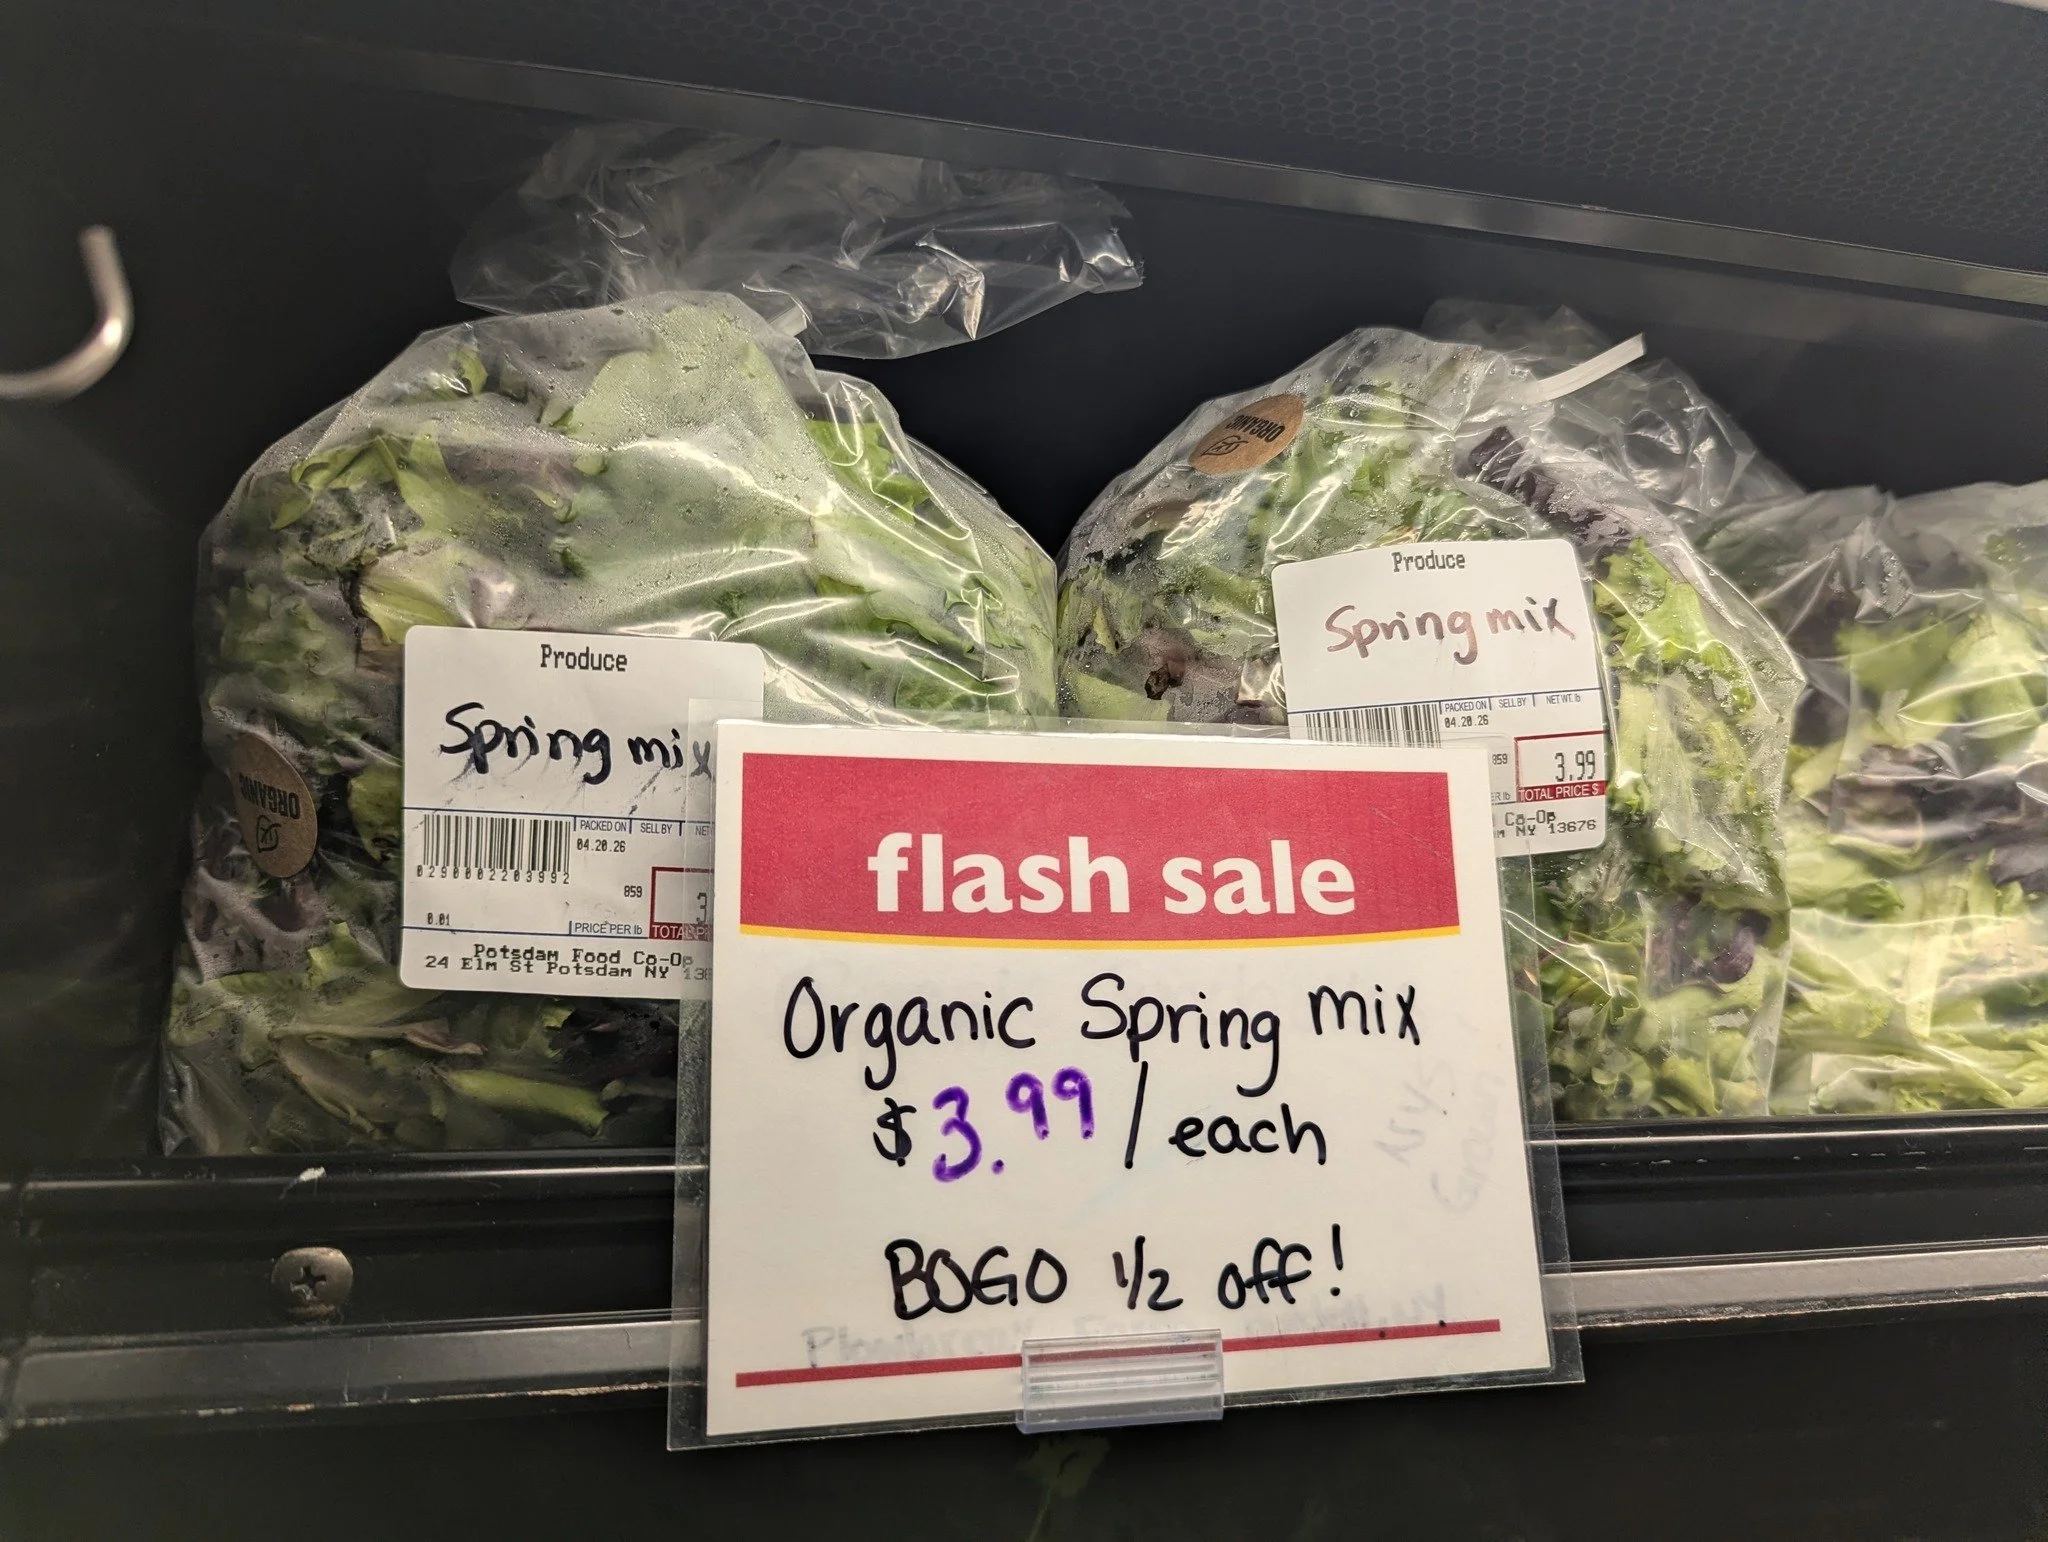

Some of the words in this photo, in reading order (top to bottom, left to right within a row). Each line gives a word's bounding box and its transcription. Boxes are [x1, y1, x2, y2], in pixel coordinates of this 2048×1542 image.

[1224, 414, 1285, 443] ORGANIC
[1391, 550, 1466, 573] Produce
[1324, 605, 1479, 666] Spring
[1486, 596, 1576, 641] mix
[540, 643, 628, 672] Produce
[1444, 701, 1474, 713] PACKED
[1475, 700, 1487, 710] ON
[1498, 698, 1516, 709] SELL
[1516, 697, 1527, 707] BY
[1546, 694, 1560, 705] NET
[1444, 714, 1489, 729] 04.20.26
[440, 701, 612, 785] Spring
[627, 728, 712, 780] mix
[1492, 753, 1508, 765] 859
[1554, 750, 1596, 782] 3.99
[1518, 788, 1553, 802] TOTAL
[1555, 784, 1589, 799] PRICE
[1591, 783, 1600, 796] $
[580, 819, 613, 832] PACKED
[613, 821, 627, 833] ON
[1504, 809, 1556, 827] Co-Op
[640, 822, 660, 834] SELL
[661, 823, 673, 834] BY
[1515, 824, 1536, 837] NY
[1548, 819, 1597, 835] 13676
[576, 838, 627, 853] 04.20.26
[867, 831, 1131, 915] flash
[1161, 838, 1356, 917] sale
[624, 885, 643, 898] 859
[427, 912, 451, 926] 0.01
[574, 922, 607, 935] PRICE
[608, 923, 632, 935] PER
[633, 924, 643, 935] lb
[651, 924, 692, 939] TOTAL
[474, 943, 559, 962] Potsdam
[572, 948, 621, 965] Food
[633, 950, 694, 968] Co-Op
[425, 955, 449, 969] 24
[461, 957, 498, 971] Elm
[510, 959, 533, 973] St
[546, 962, 632, 978] Potsdam
[644, 965, 670, 979] NY
[782, 974, 1037, 1091] Organic
[1080, 971, 1282, 1098] Spring
[1307, 982, 1423, 1047] mix
[884, 1237, 1068, 1320] BOGO
